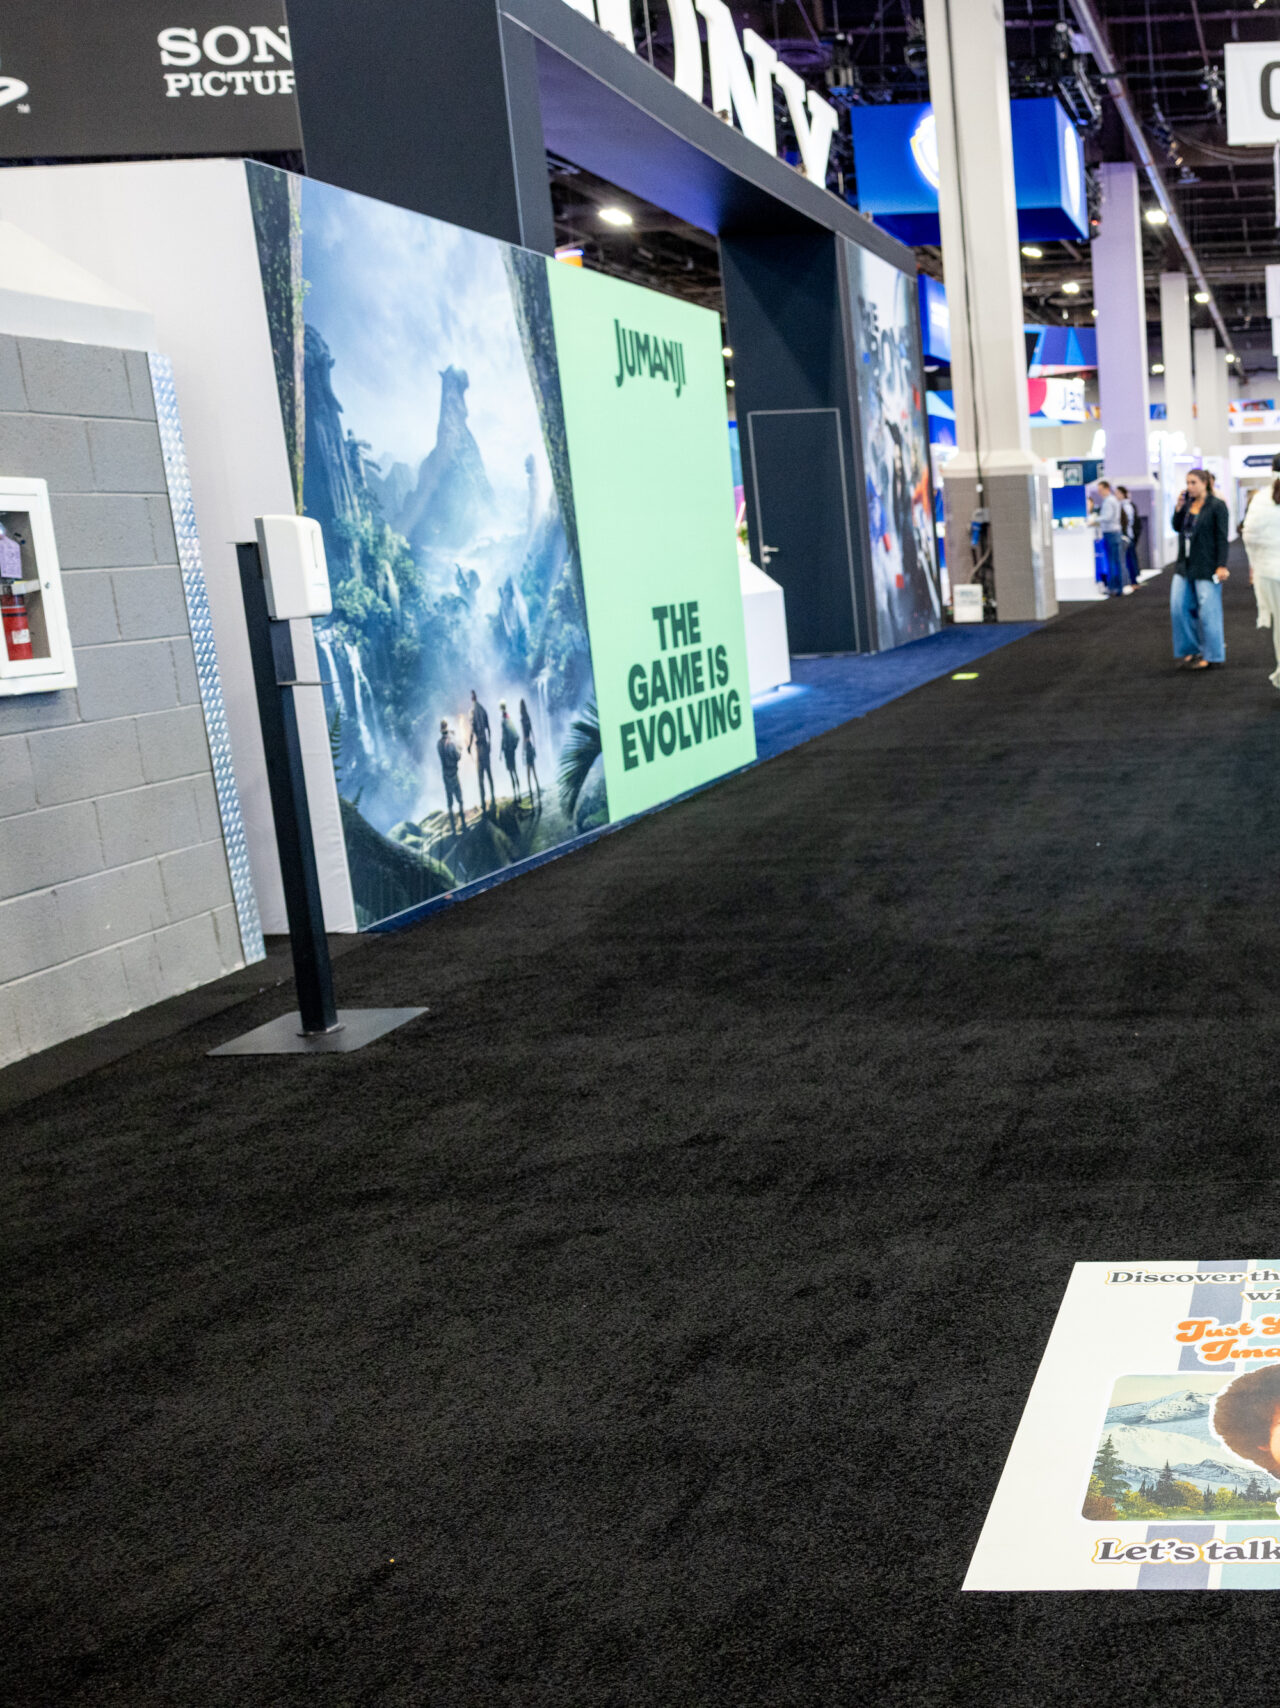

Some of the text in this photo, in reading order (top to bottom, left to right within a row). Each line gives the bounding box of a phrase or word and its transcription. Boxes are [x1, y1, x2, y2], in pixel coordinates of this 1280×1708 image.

[614, 318, 687, 399] JUMANJI
[652, 600, 701, 651] THE
[627, 643, 729, 712] GAME IS
[619, 690, 742, 771] EVOLVING
[1110, 1271, 1244, 1283] Discover
[1175, 1319, 1254, 1343] Just
[1099, 1541, 1196, 1560] Let’s
